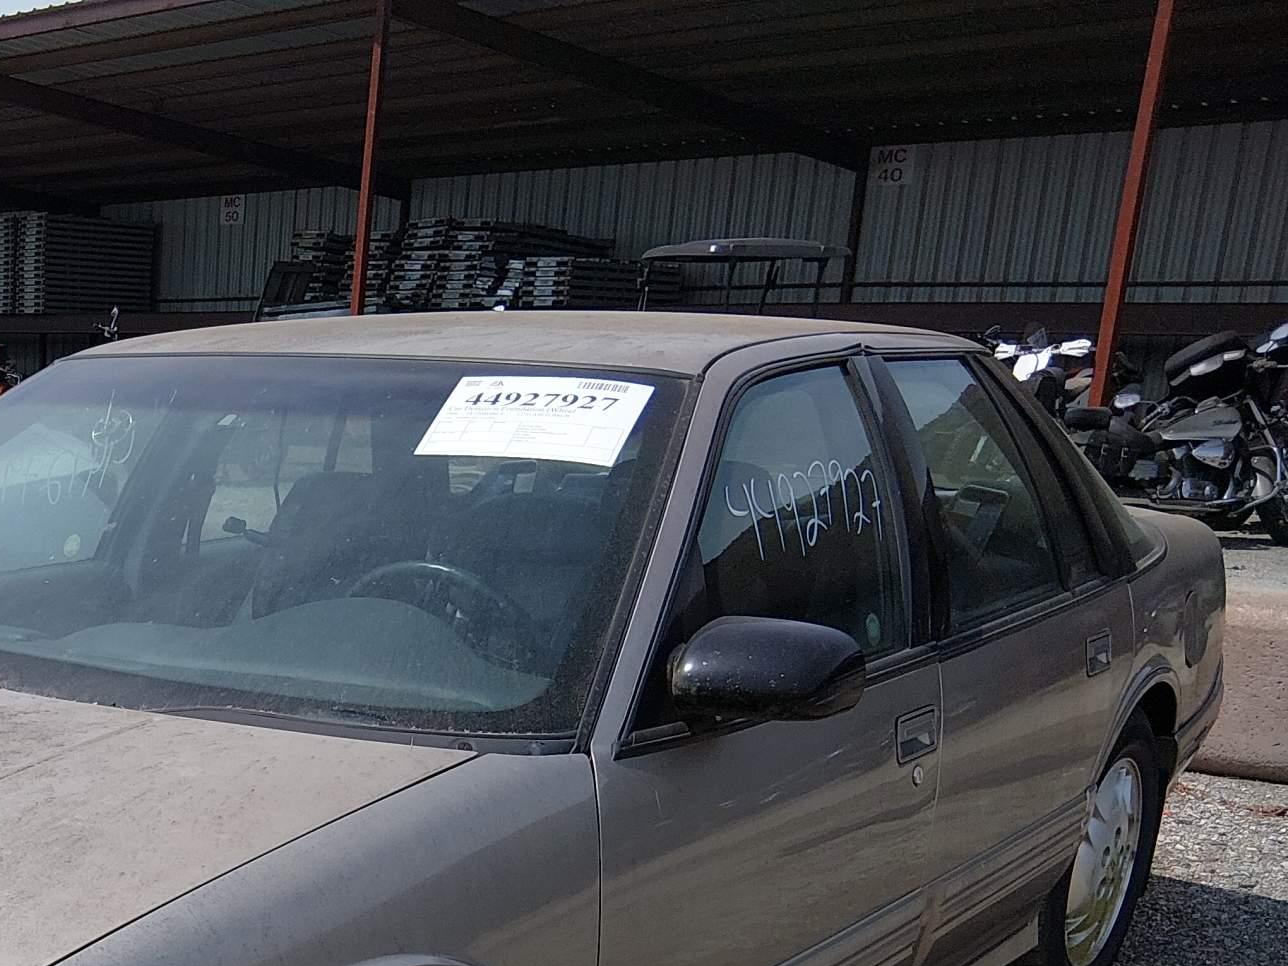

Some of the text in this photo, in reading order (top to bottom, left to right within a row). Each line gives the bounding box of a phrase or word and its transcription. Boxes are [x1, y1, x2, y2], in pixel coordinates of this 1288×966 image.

[878, 149, 908, 164] MC
[878, 168, 903, 182] 40
[224, 196, 241, 208] MC
[224, 211, 240, 222] 50
[465, 391, 621, 412] 44927927
[725, 459, 883, 561] 44927927
